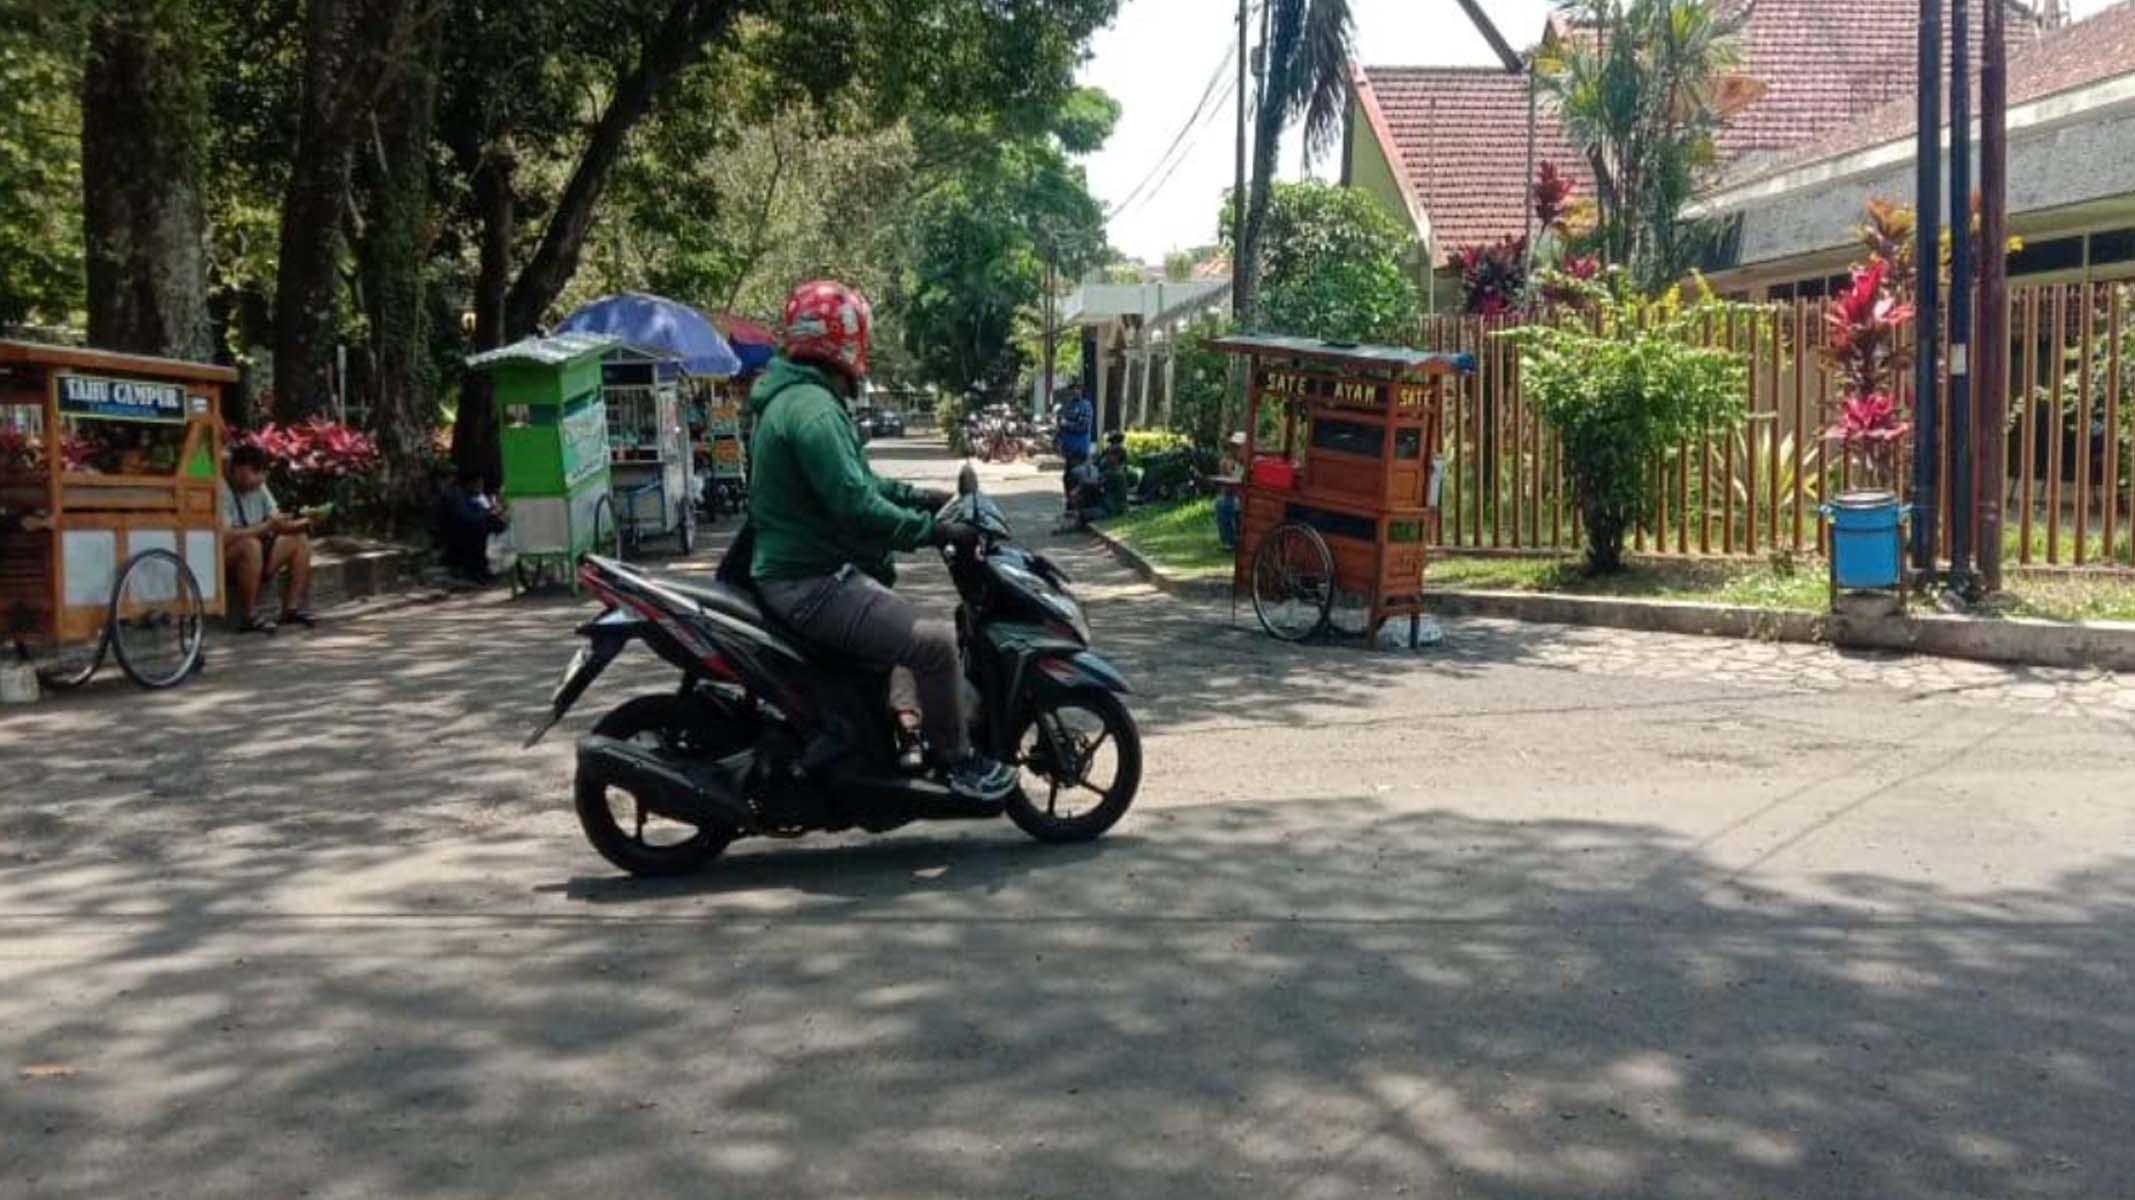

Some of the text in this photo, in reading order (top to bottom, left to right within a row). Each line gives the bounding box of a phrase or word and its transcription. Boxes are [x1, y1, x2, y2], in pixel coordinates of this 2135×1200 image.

[66, 379, 108, 401] TAHU
[113, 383, 179, 408] CAMPUR
[1266, 372, 1376, 406] SATE AYAM
[1399, 388, 1433, 407] SATE
